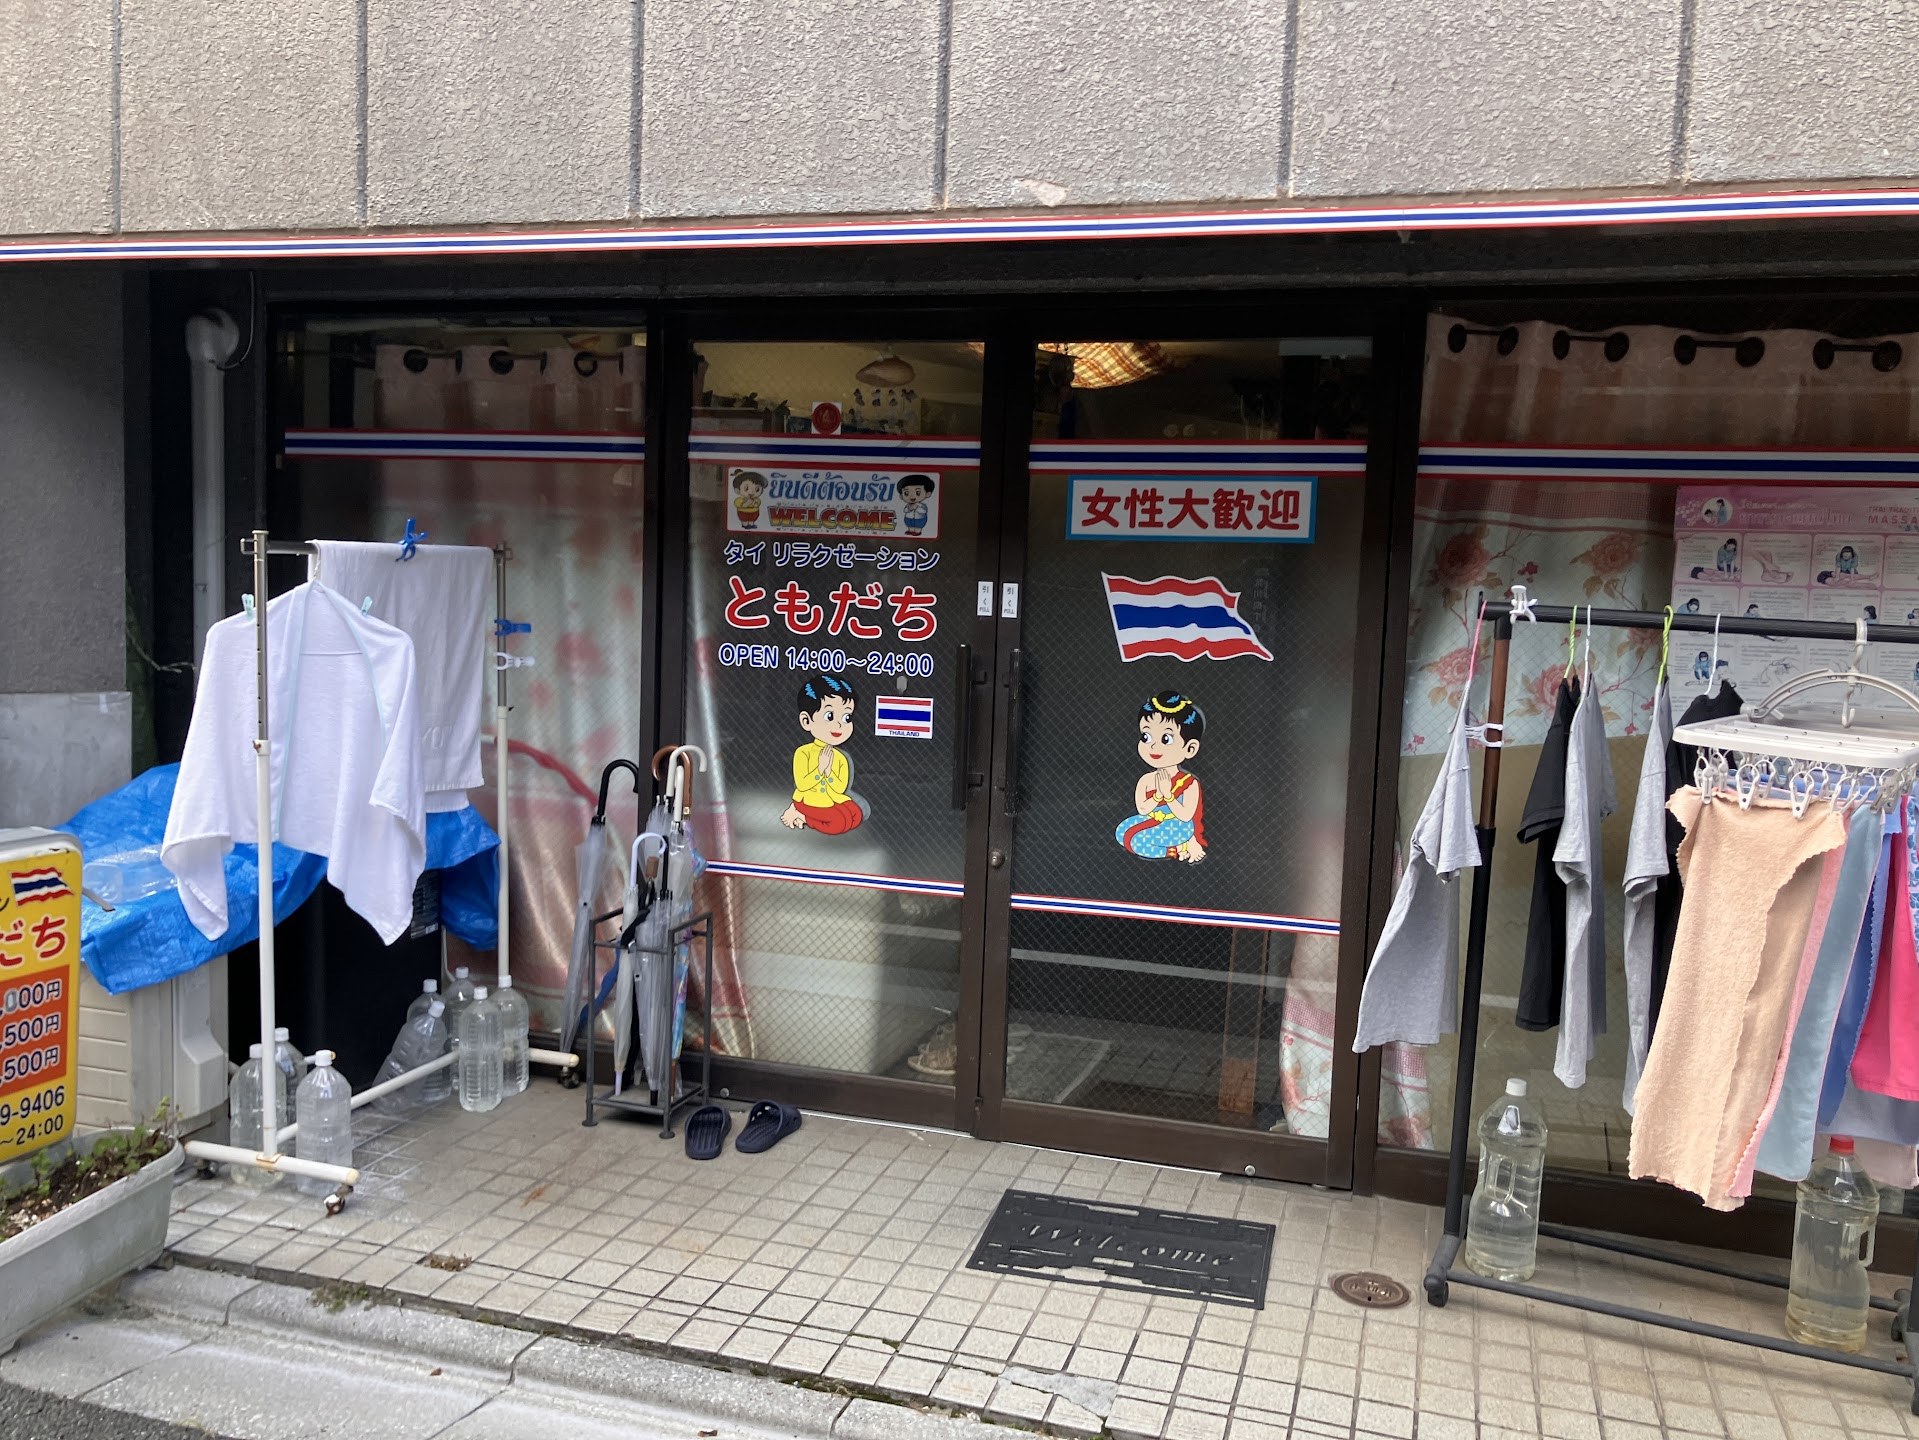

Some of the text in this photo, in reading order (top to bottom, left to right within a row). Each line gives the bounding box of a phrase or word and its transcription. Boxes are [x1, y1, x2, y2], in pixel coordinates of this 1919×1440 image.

[768, 471, 896, 502] ยินดีต้อนรับ
[767, 506, 897, 532] WELCOME
[1081, 487, 1300, 531] 女性大歓迎
[723, 539, 940, 571] タイ リラクゼーション
[724, 575, 938, 641] ともだち
[718, 643, 779, 669] OPEN
